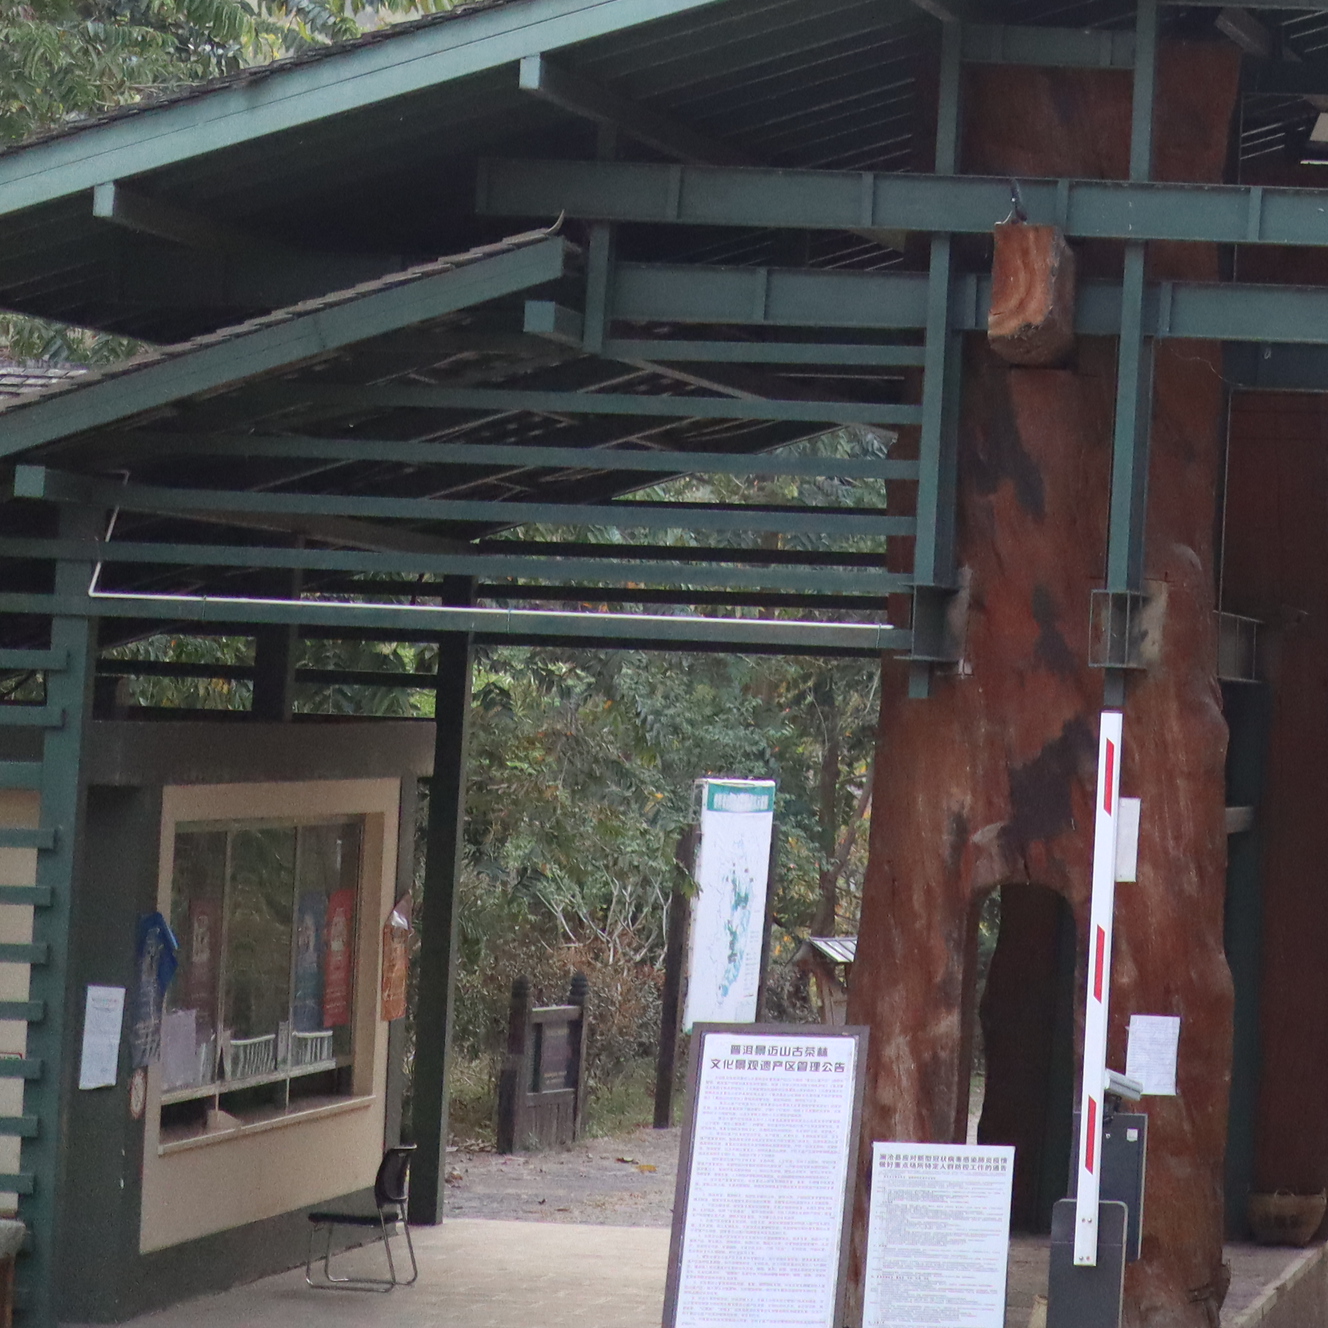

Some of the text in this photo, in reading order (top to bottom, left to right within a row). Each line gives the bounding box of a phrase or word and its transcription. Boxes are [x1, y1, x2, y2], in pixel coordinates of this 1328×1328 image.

[730, 1044, 828, 1058] 普洱景迈山古茶林
[710, 1058, 846, 1073] 文化景观遗产区管理公告
